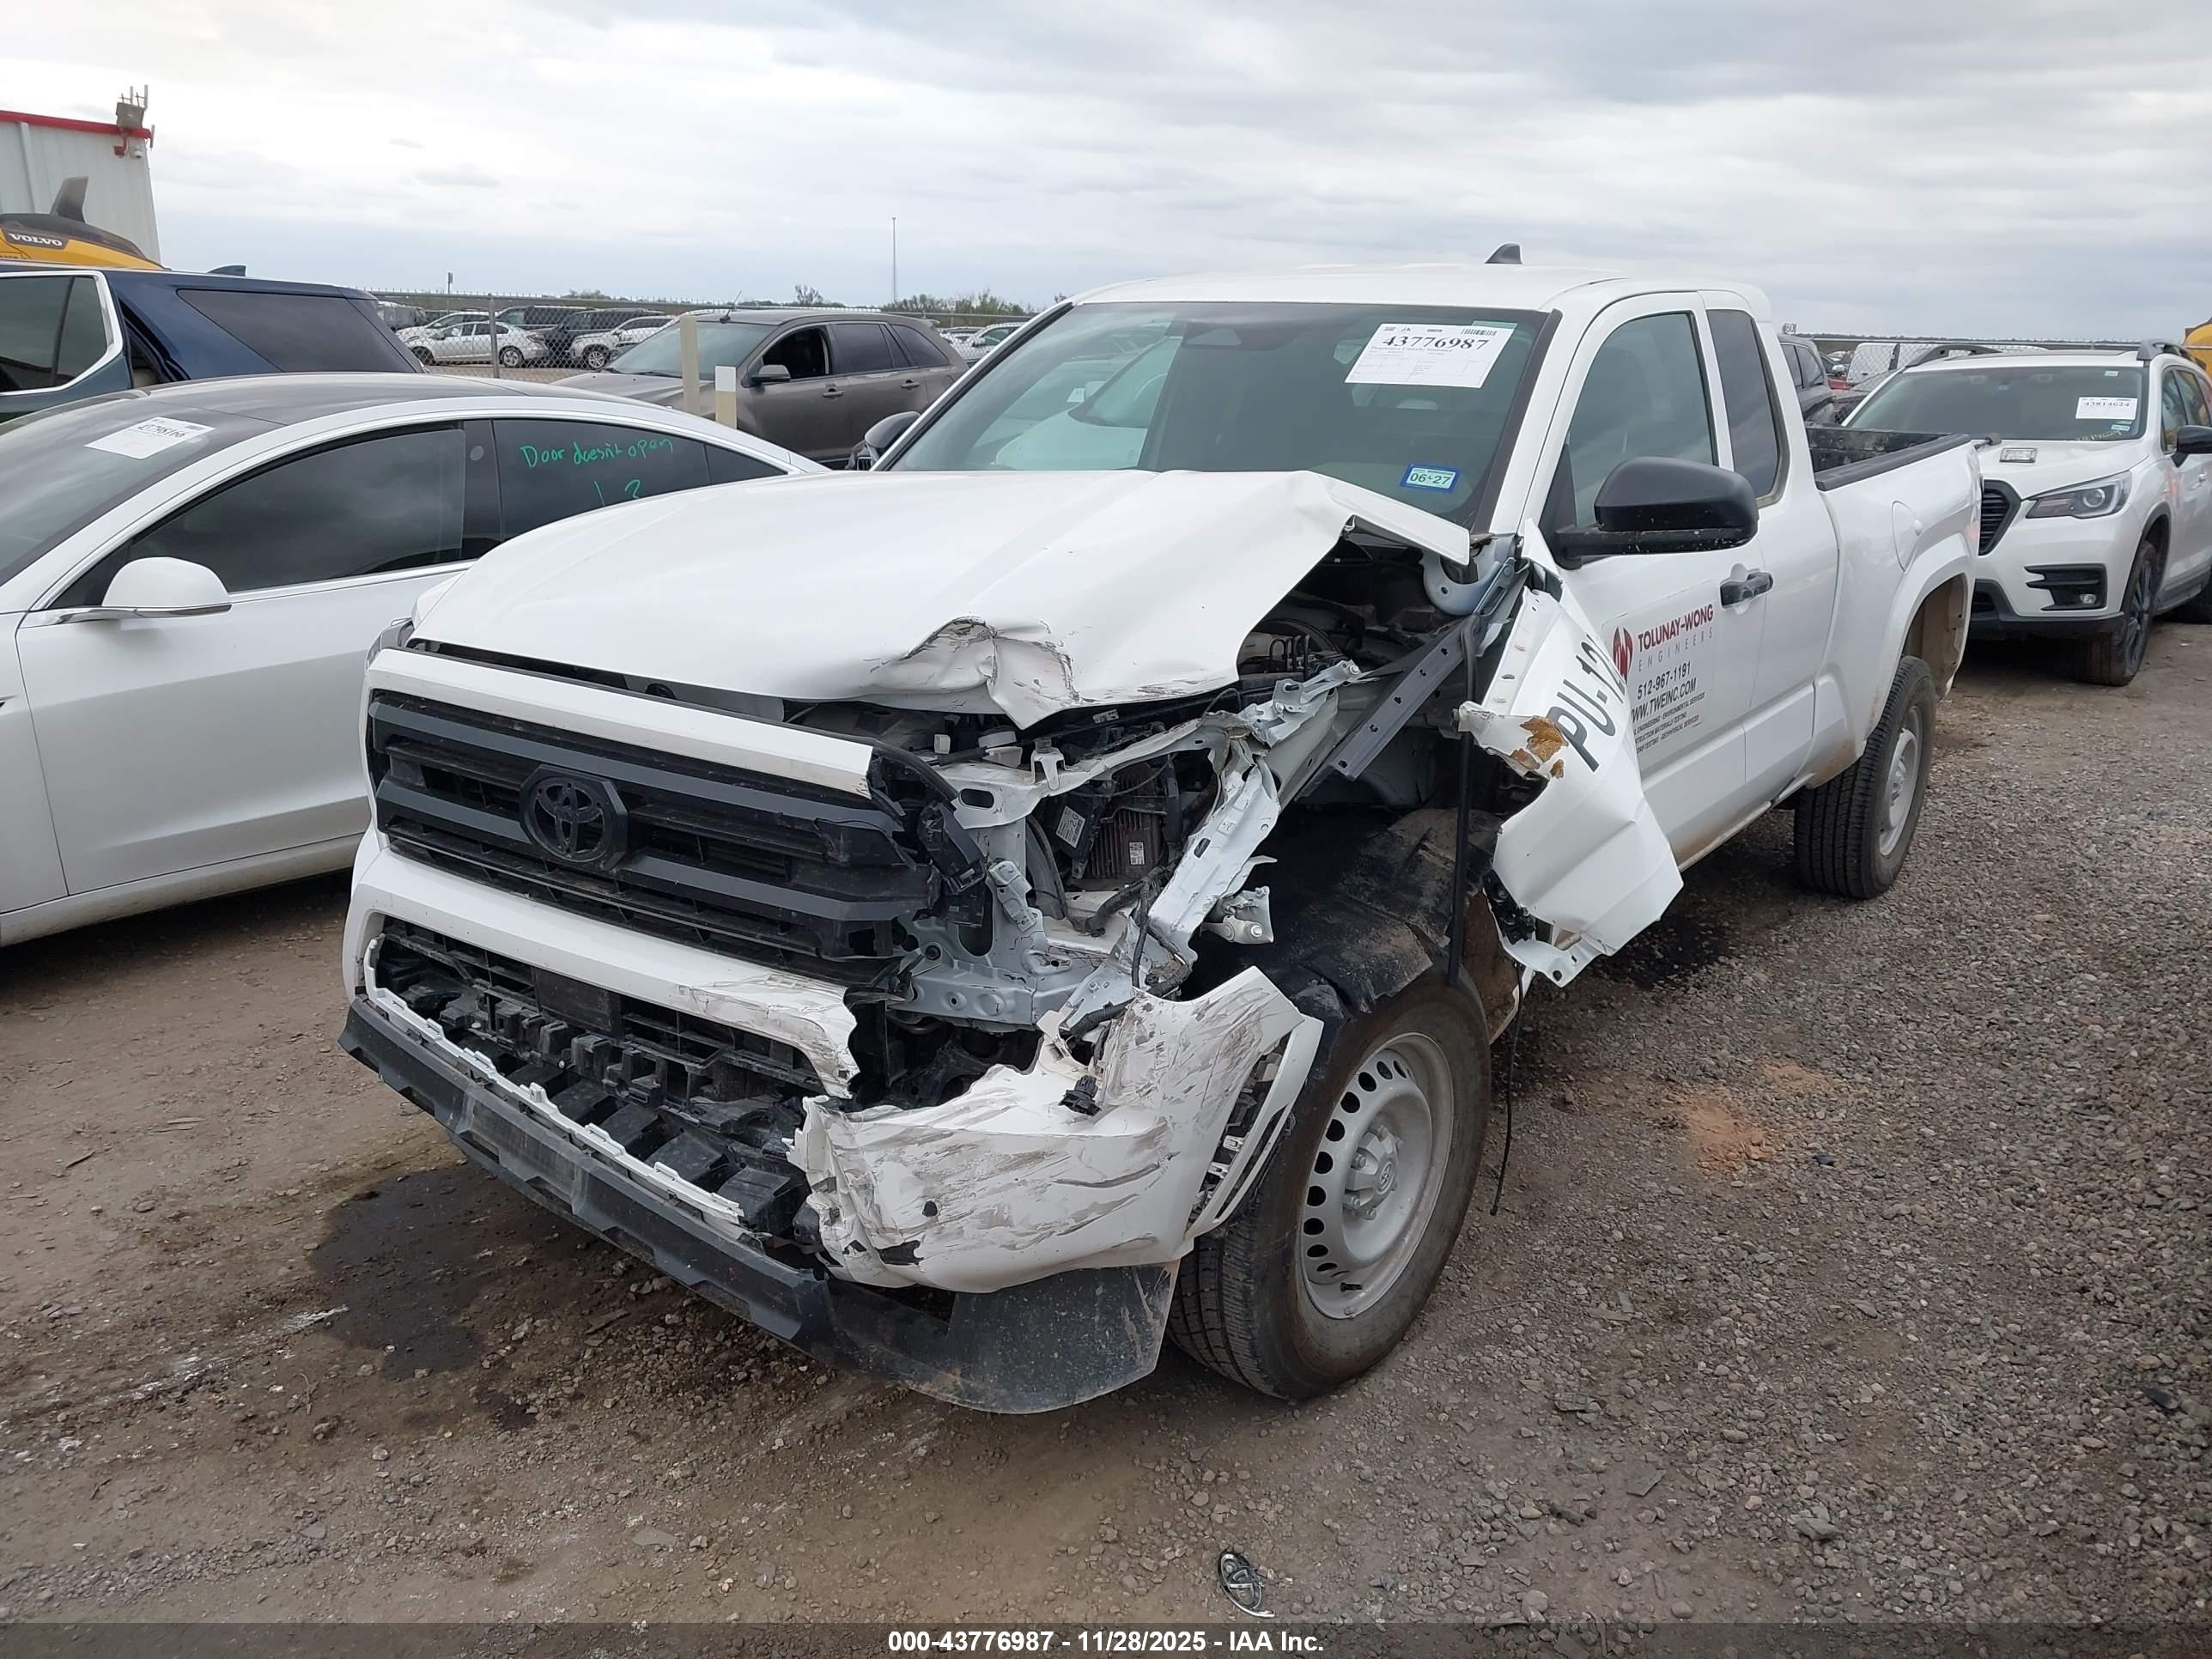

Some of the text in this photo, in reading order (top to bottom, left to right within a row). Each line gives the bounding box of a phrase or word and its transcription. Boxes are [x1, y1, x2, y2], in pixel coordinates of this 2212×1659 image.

[8, 233, 63, 246] VOLVO
[1382, 335, 1491, 350] 43776987
[520, 445, 566, 468] Door
[628, 438, 673, 459] open
[1410, 472, 1451, 485] 06 27
[1638, 604, 1714, 653] TOLUNAY-WONG
[1638, 627, 1713, 672] ENGINEERS
[1638, 660, 1691, 700] 512-967-1191
[1631, 678, 1697, 723] WW.TWEINC.COM
